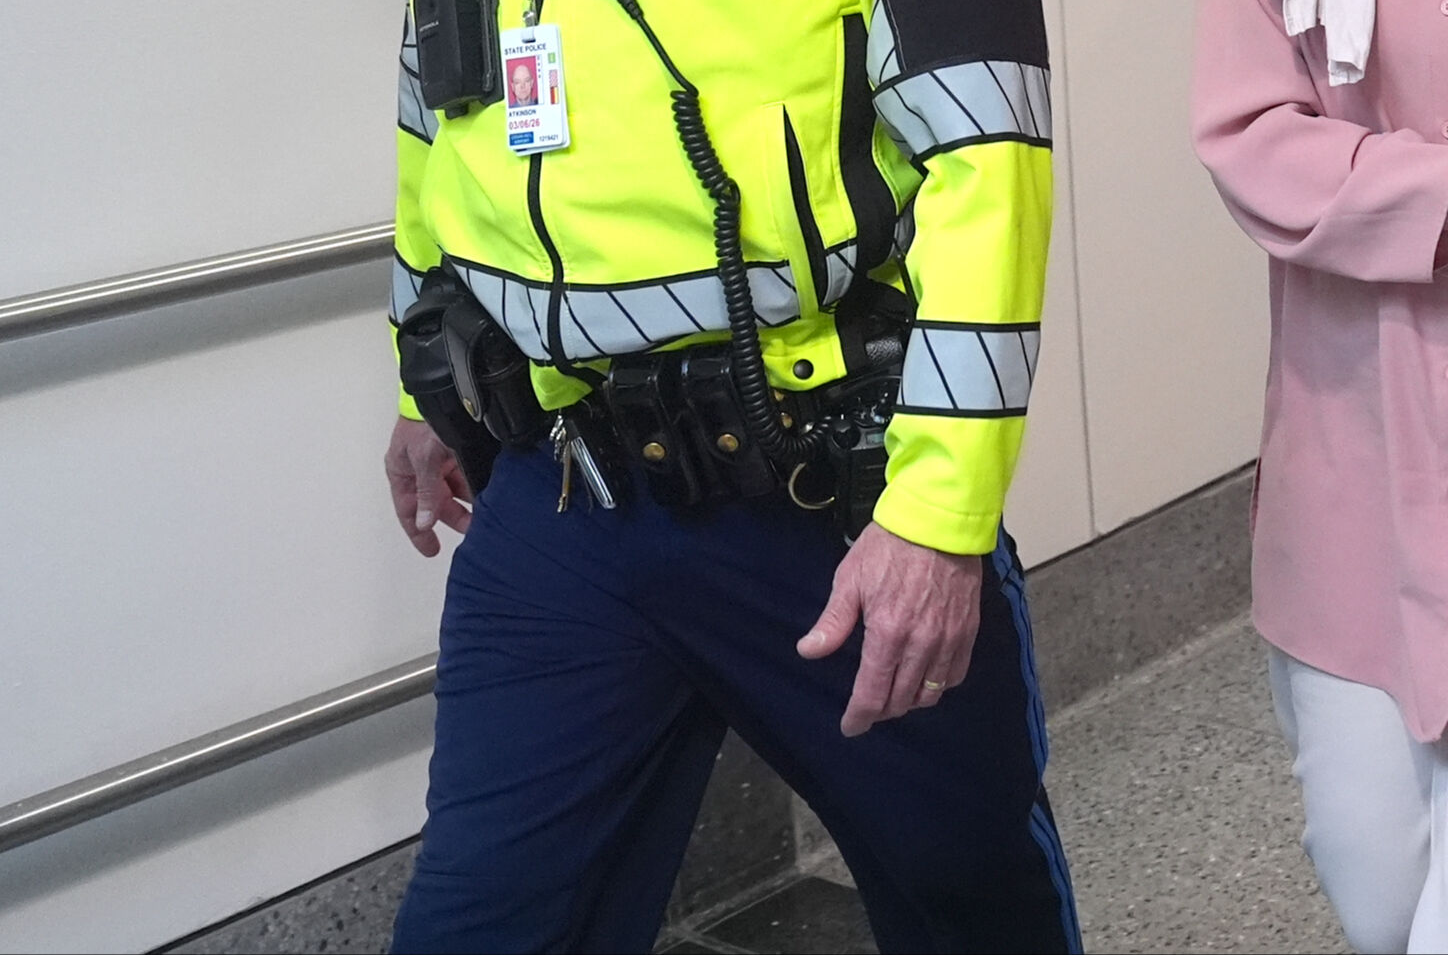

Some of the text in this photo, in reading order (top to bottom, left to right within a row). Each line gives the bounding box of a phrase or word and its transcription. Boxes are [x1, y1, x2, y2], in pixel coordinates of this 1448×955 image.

[504, 43, 546, 55] STATE POLICE
[508, 109, 537, 117] ATKINSON
